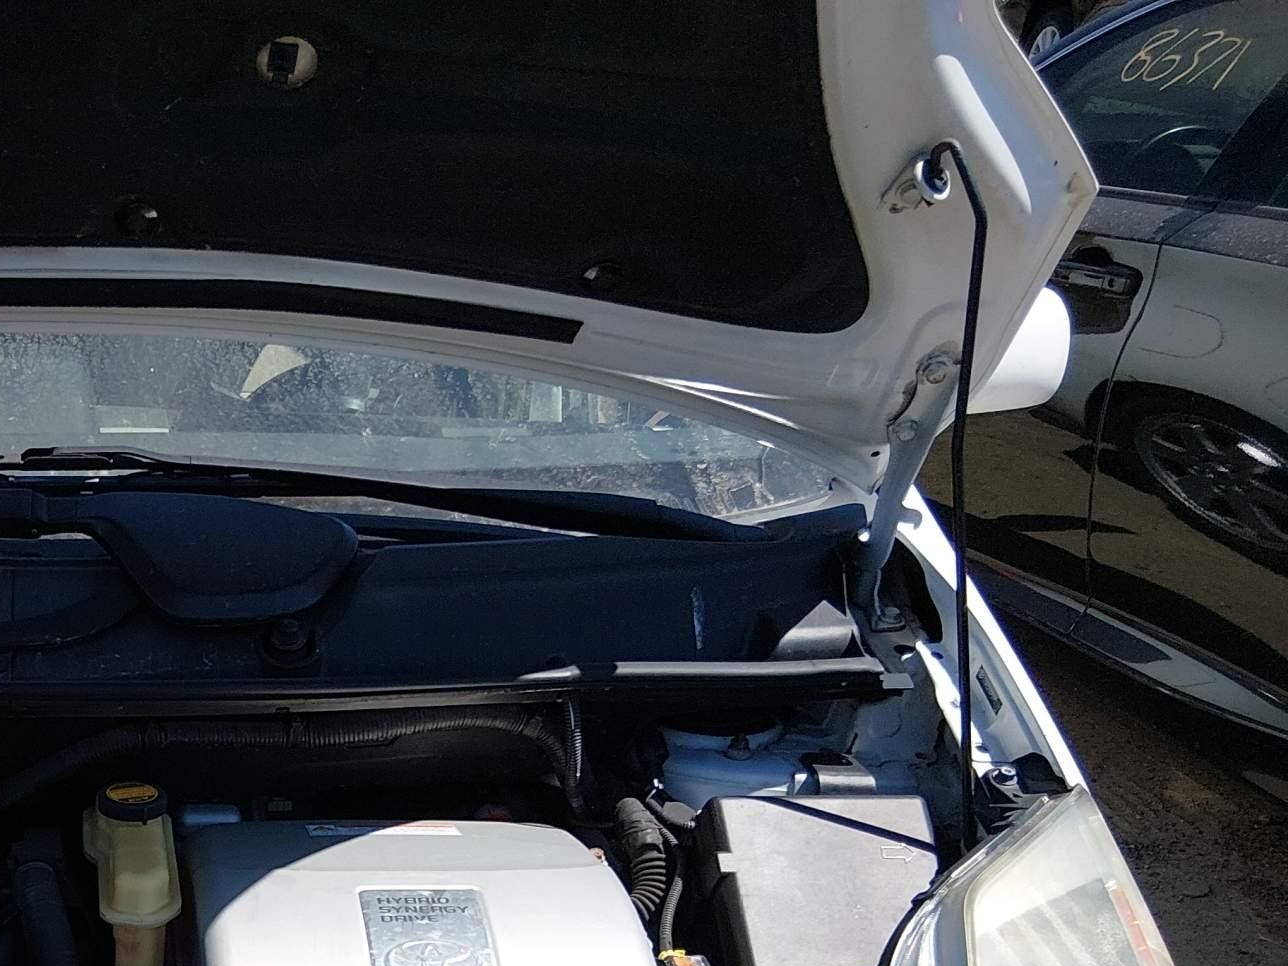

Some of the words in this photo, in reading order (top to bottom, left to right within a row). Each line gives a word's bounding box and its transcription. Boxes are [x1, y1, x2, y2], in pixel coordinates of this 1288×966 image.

[1121, 28, 1252, 92] 86371
[376, 896, 450, 905] HYBRID
[378, 905, 469, 914] SYNERGY
[381, 915, 440, 923] DRIVE
